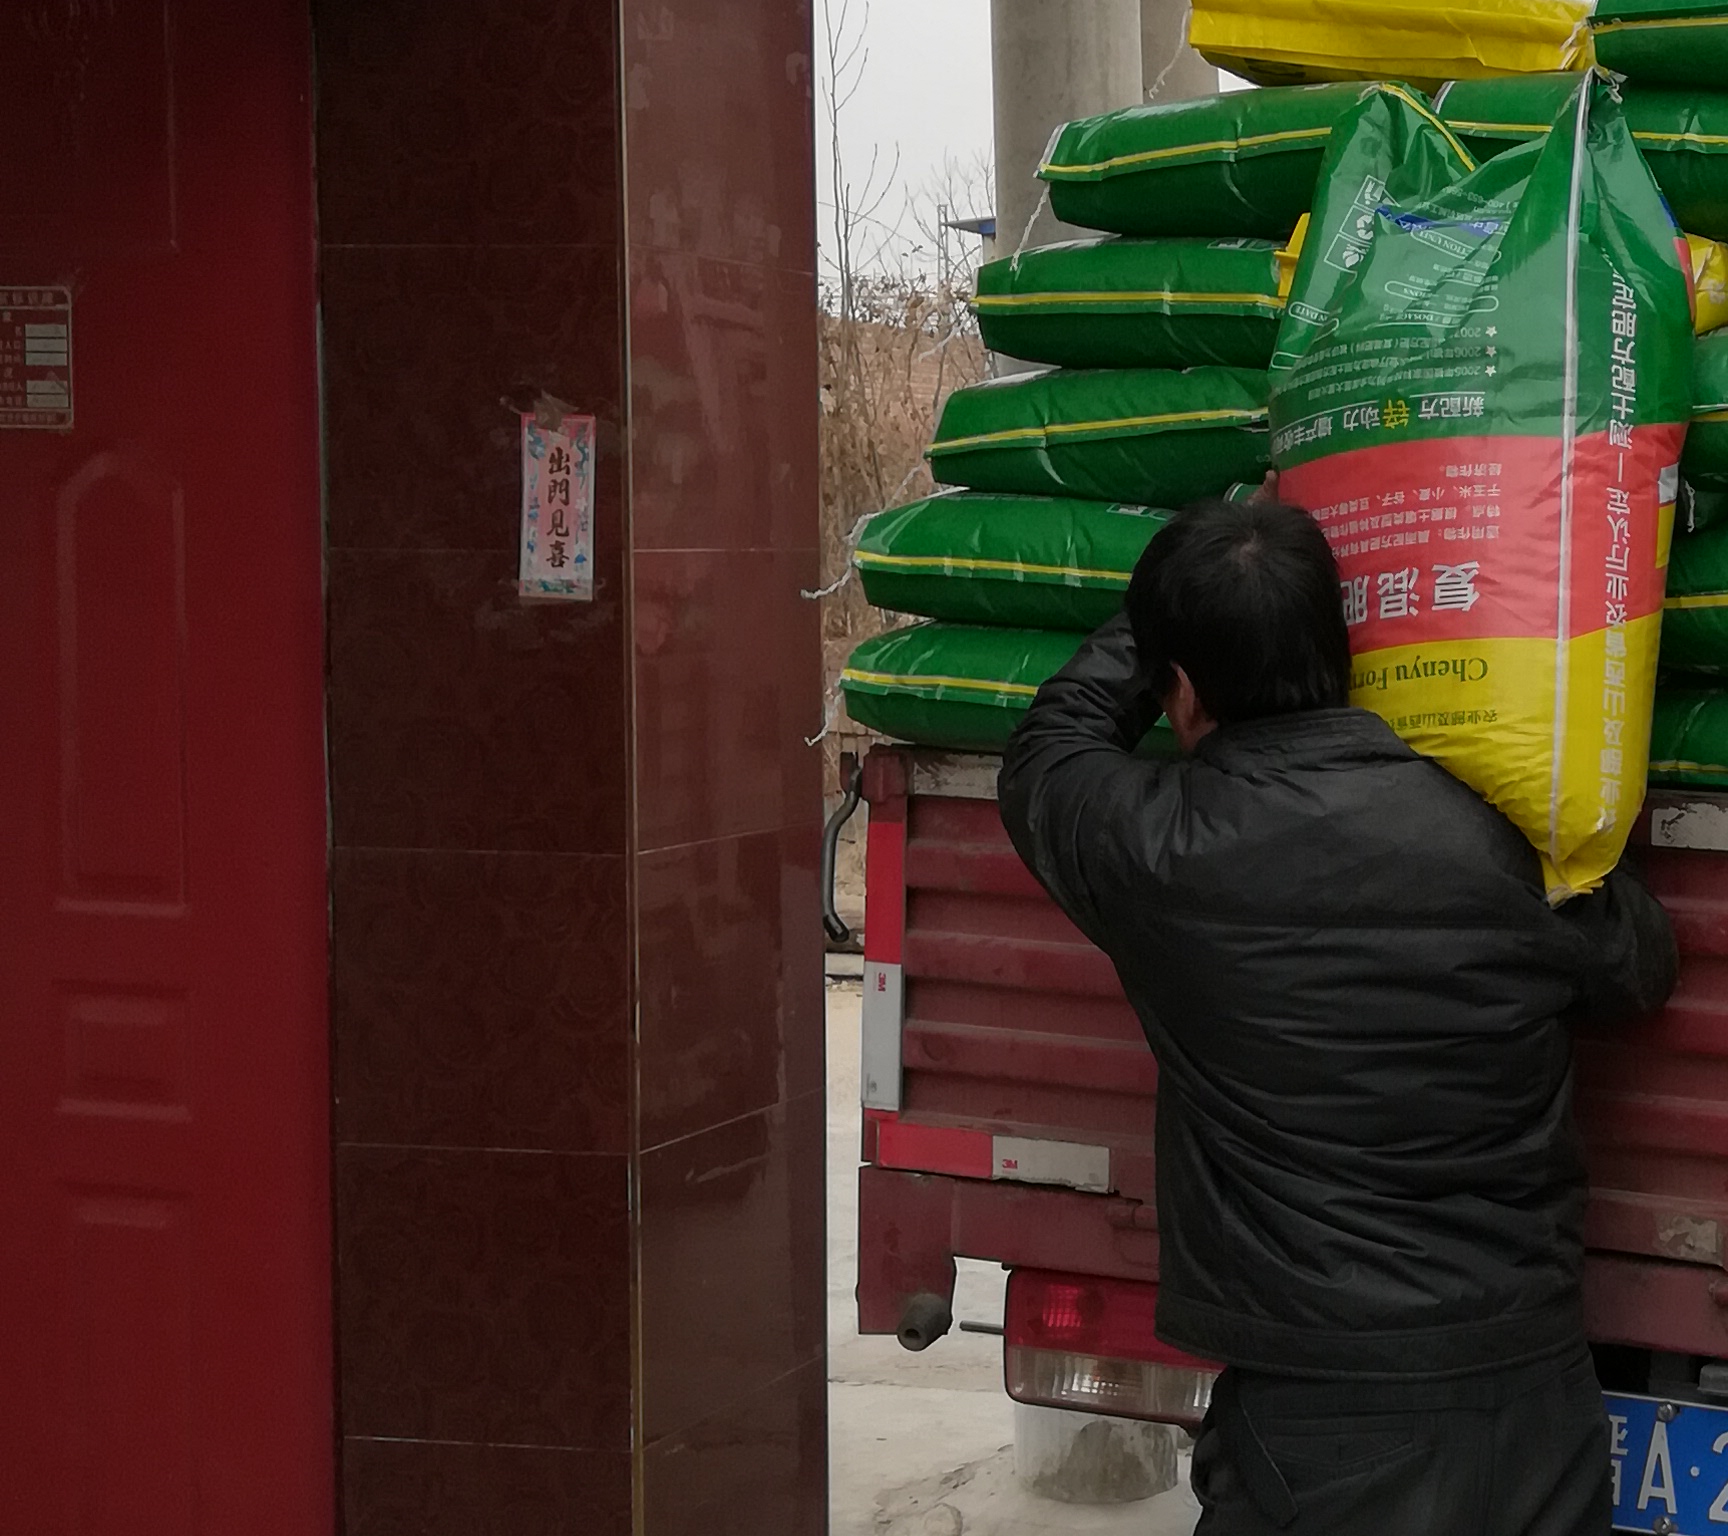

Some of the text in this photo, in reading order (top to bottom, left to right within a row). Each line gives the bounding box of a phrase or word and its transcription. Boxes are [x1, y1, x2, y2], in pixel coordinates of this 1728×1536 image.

[1342, 405, 1380, 431] 动力
[1418, 395, 1485, 419] 新配方
[545, 446, 572, 569] 出門見喜
[1394, 655, 1489, 683] Chenyu
